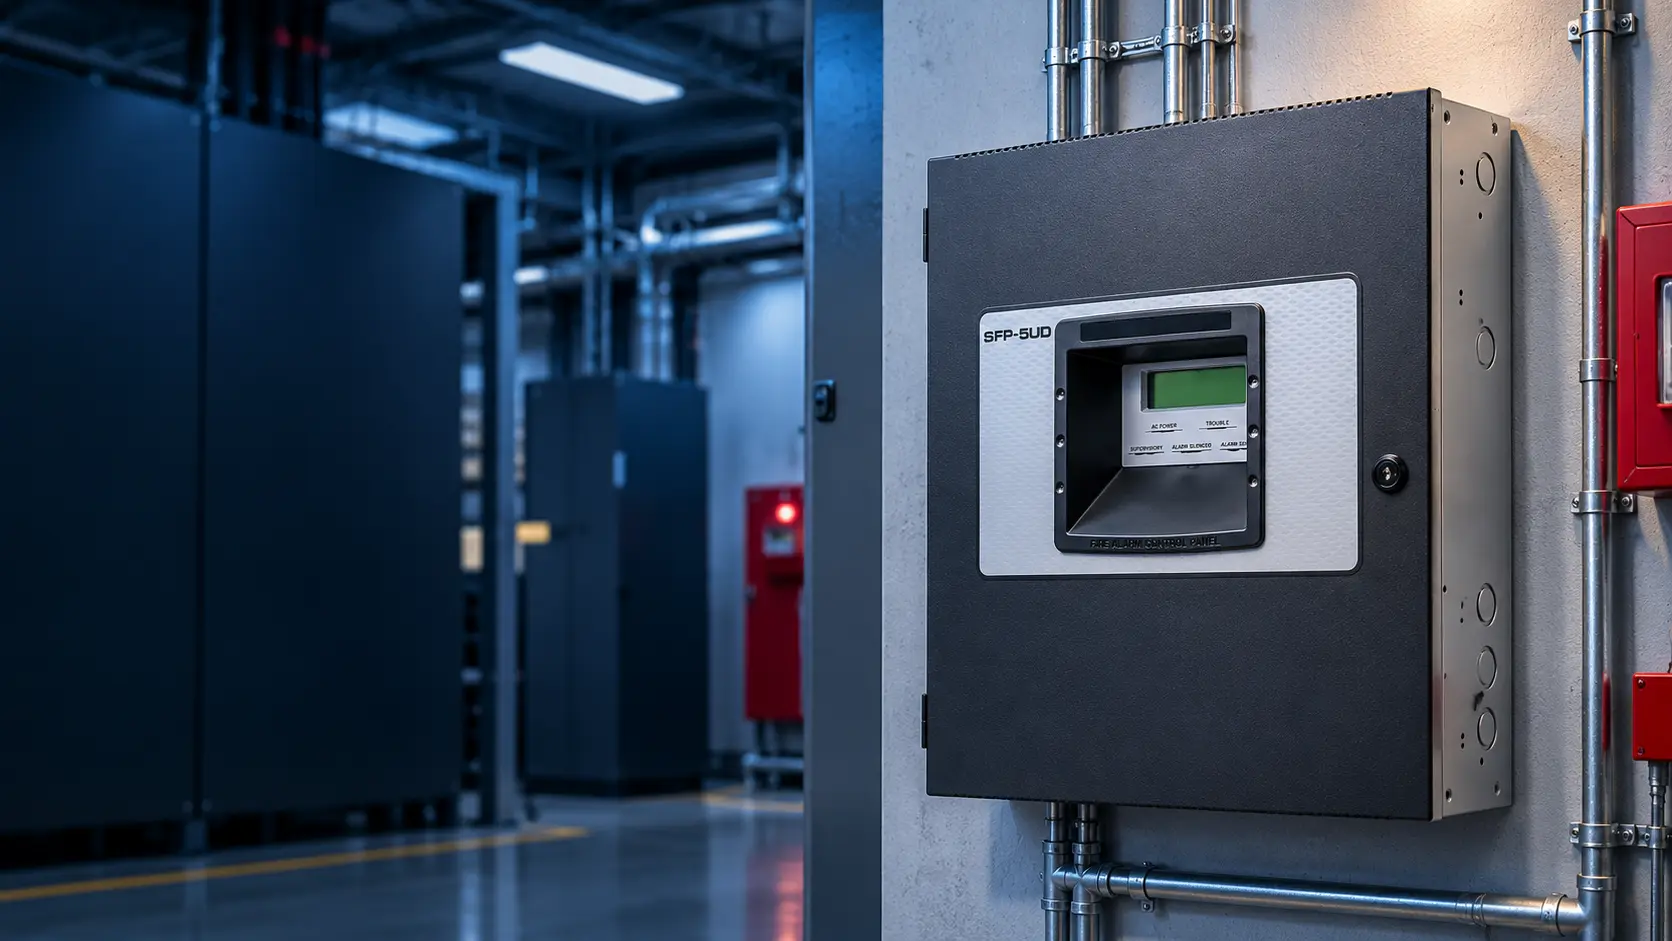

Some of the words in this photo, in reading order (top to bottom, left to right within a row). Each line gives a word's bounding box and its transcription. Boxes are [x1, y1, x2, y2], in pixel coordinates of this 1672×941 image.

[984, 326, 1052, 343] SFP-5UD
[1159, 422, 1178, 430] POWER
[1090, 539, 1110, 550] FIRE
[1111, 539, 1144, 550] ALARM
[1144, 538, 1188, 550] CONTROL
[1190, 535, 1222, 548] PANEL
